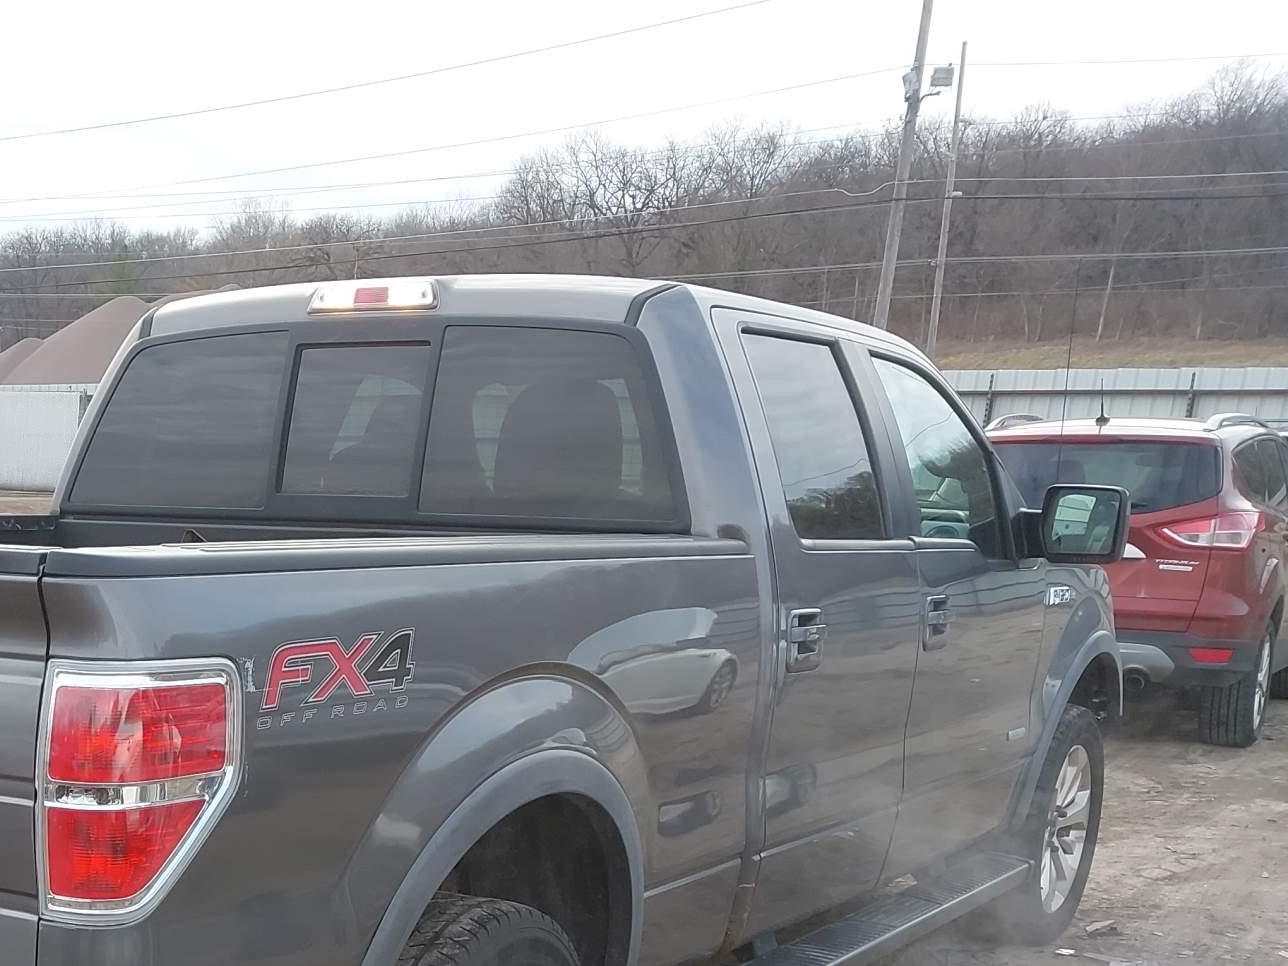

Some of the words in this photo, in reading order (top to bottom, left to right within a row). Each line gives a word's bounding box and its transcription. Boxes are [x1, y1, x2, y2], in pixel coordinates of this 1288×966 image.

[260, 627, 415, 712] FX4
[257, 709, 318, 730] OFF
[330, 695, 409, 719] ROAD
